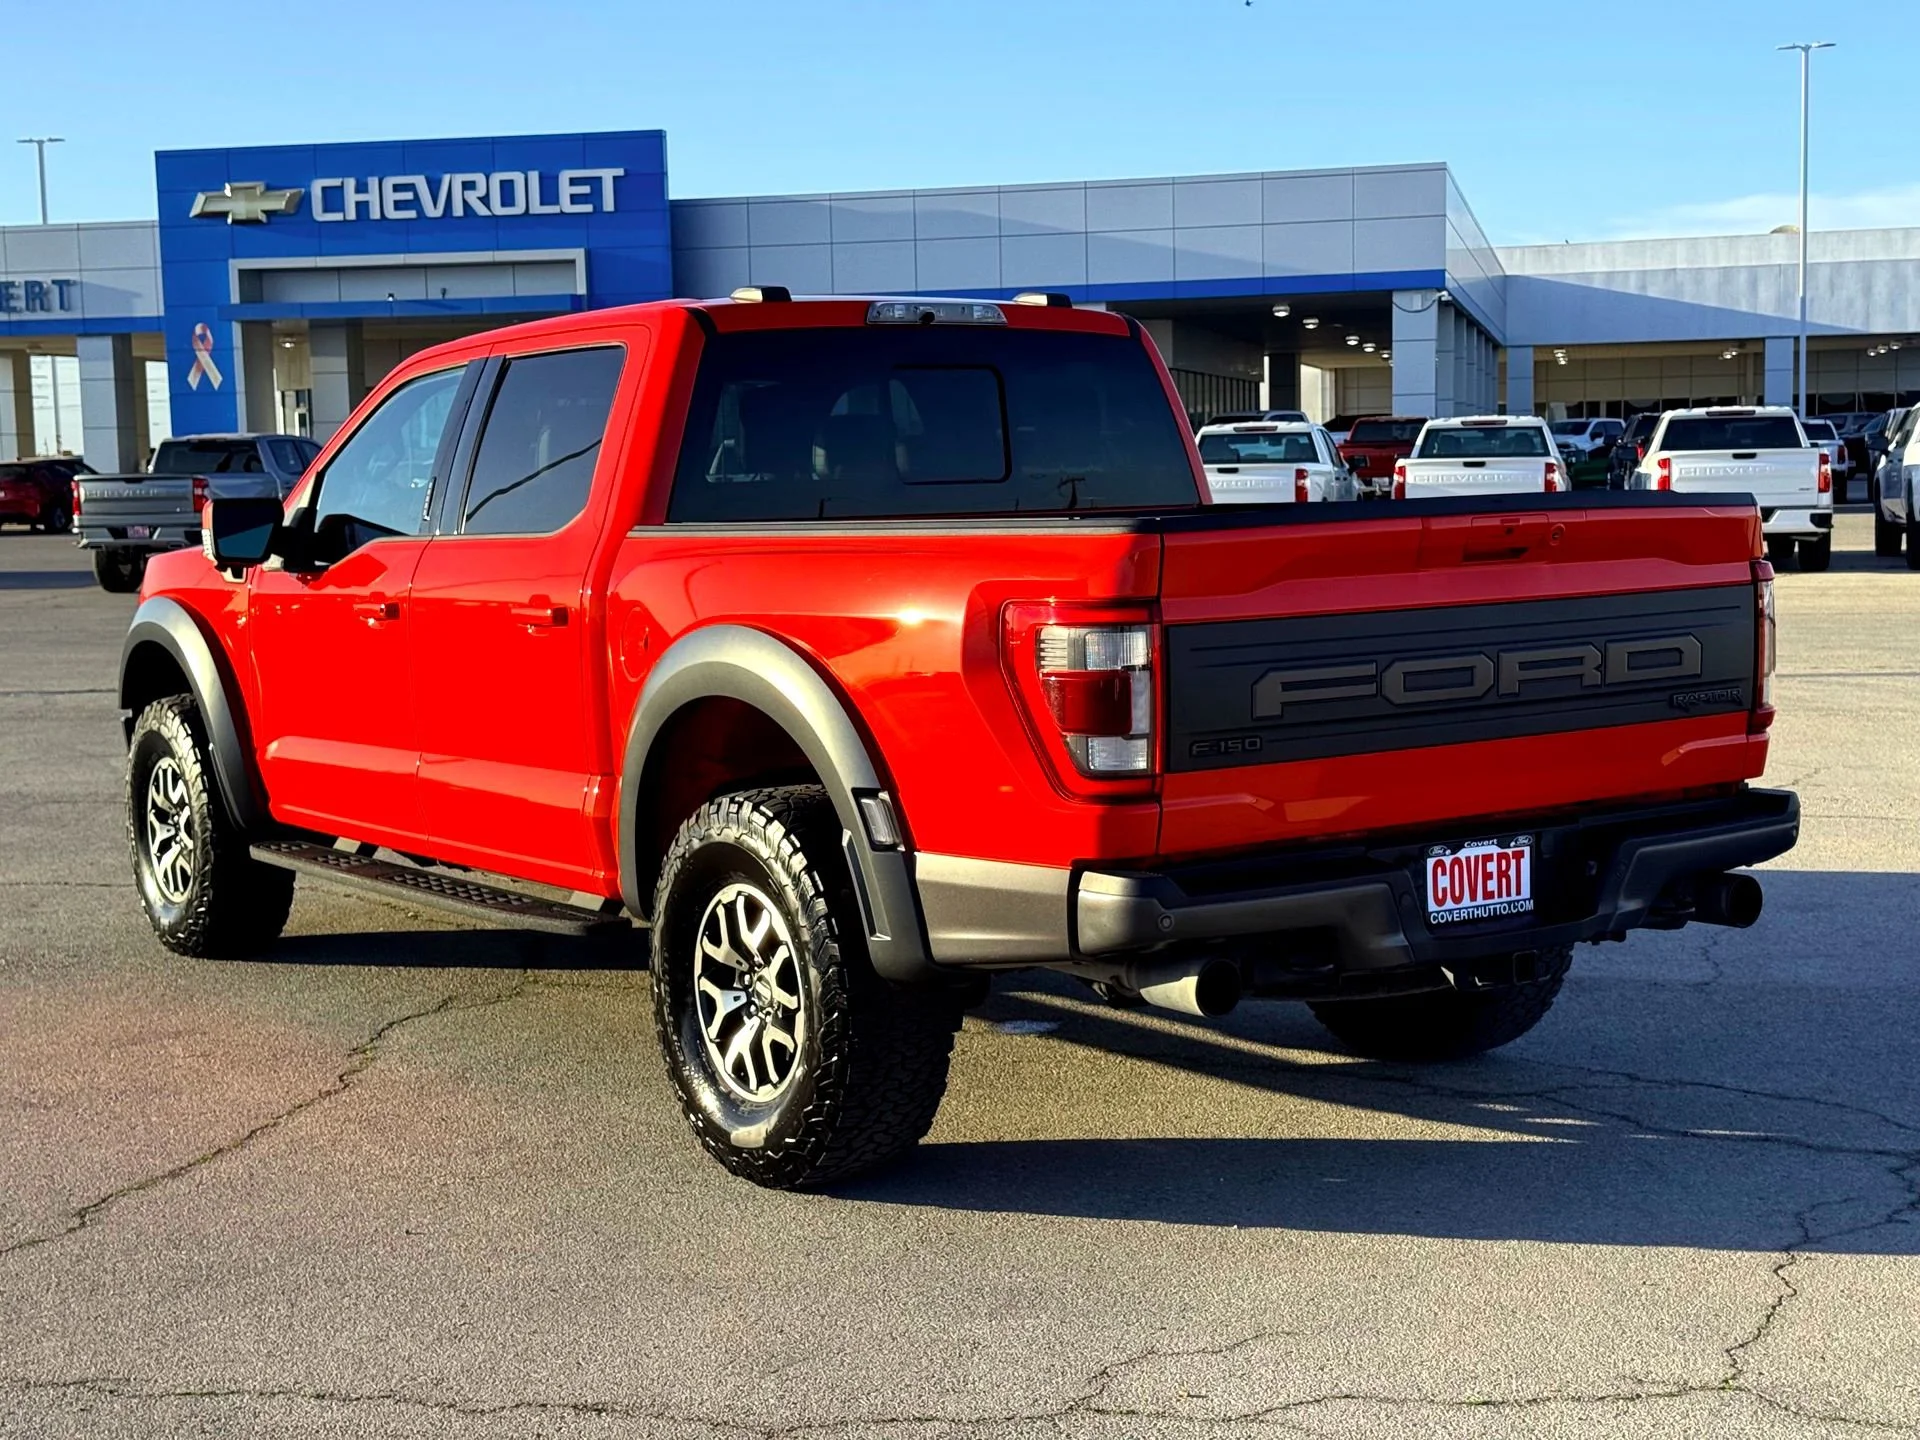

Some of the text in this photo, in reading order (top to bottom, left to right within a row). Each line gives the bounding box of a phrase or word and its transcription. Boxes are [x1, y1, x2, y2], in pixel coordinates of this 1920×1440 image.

[310, 167, 625, 222] CHEVROLET
[0, 279, 77, 313] ERT
[1250, 633, 1703, 720] FORD
[1673, 687, 1742, 707] RAPTOR
[1191, 738, 1261, 756] F-150
[1464, 838, 1498, 849] Covert
[1432, 849, 1525, 908] COVERT
[1430, 899, 1534, 924] COVERTHUTTO.COM
